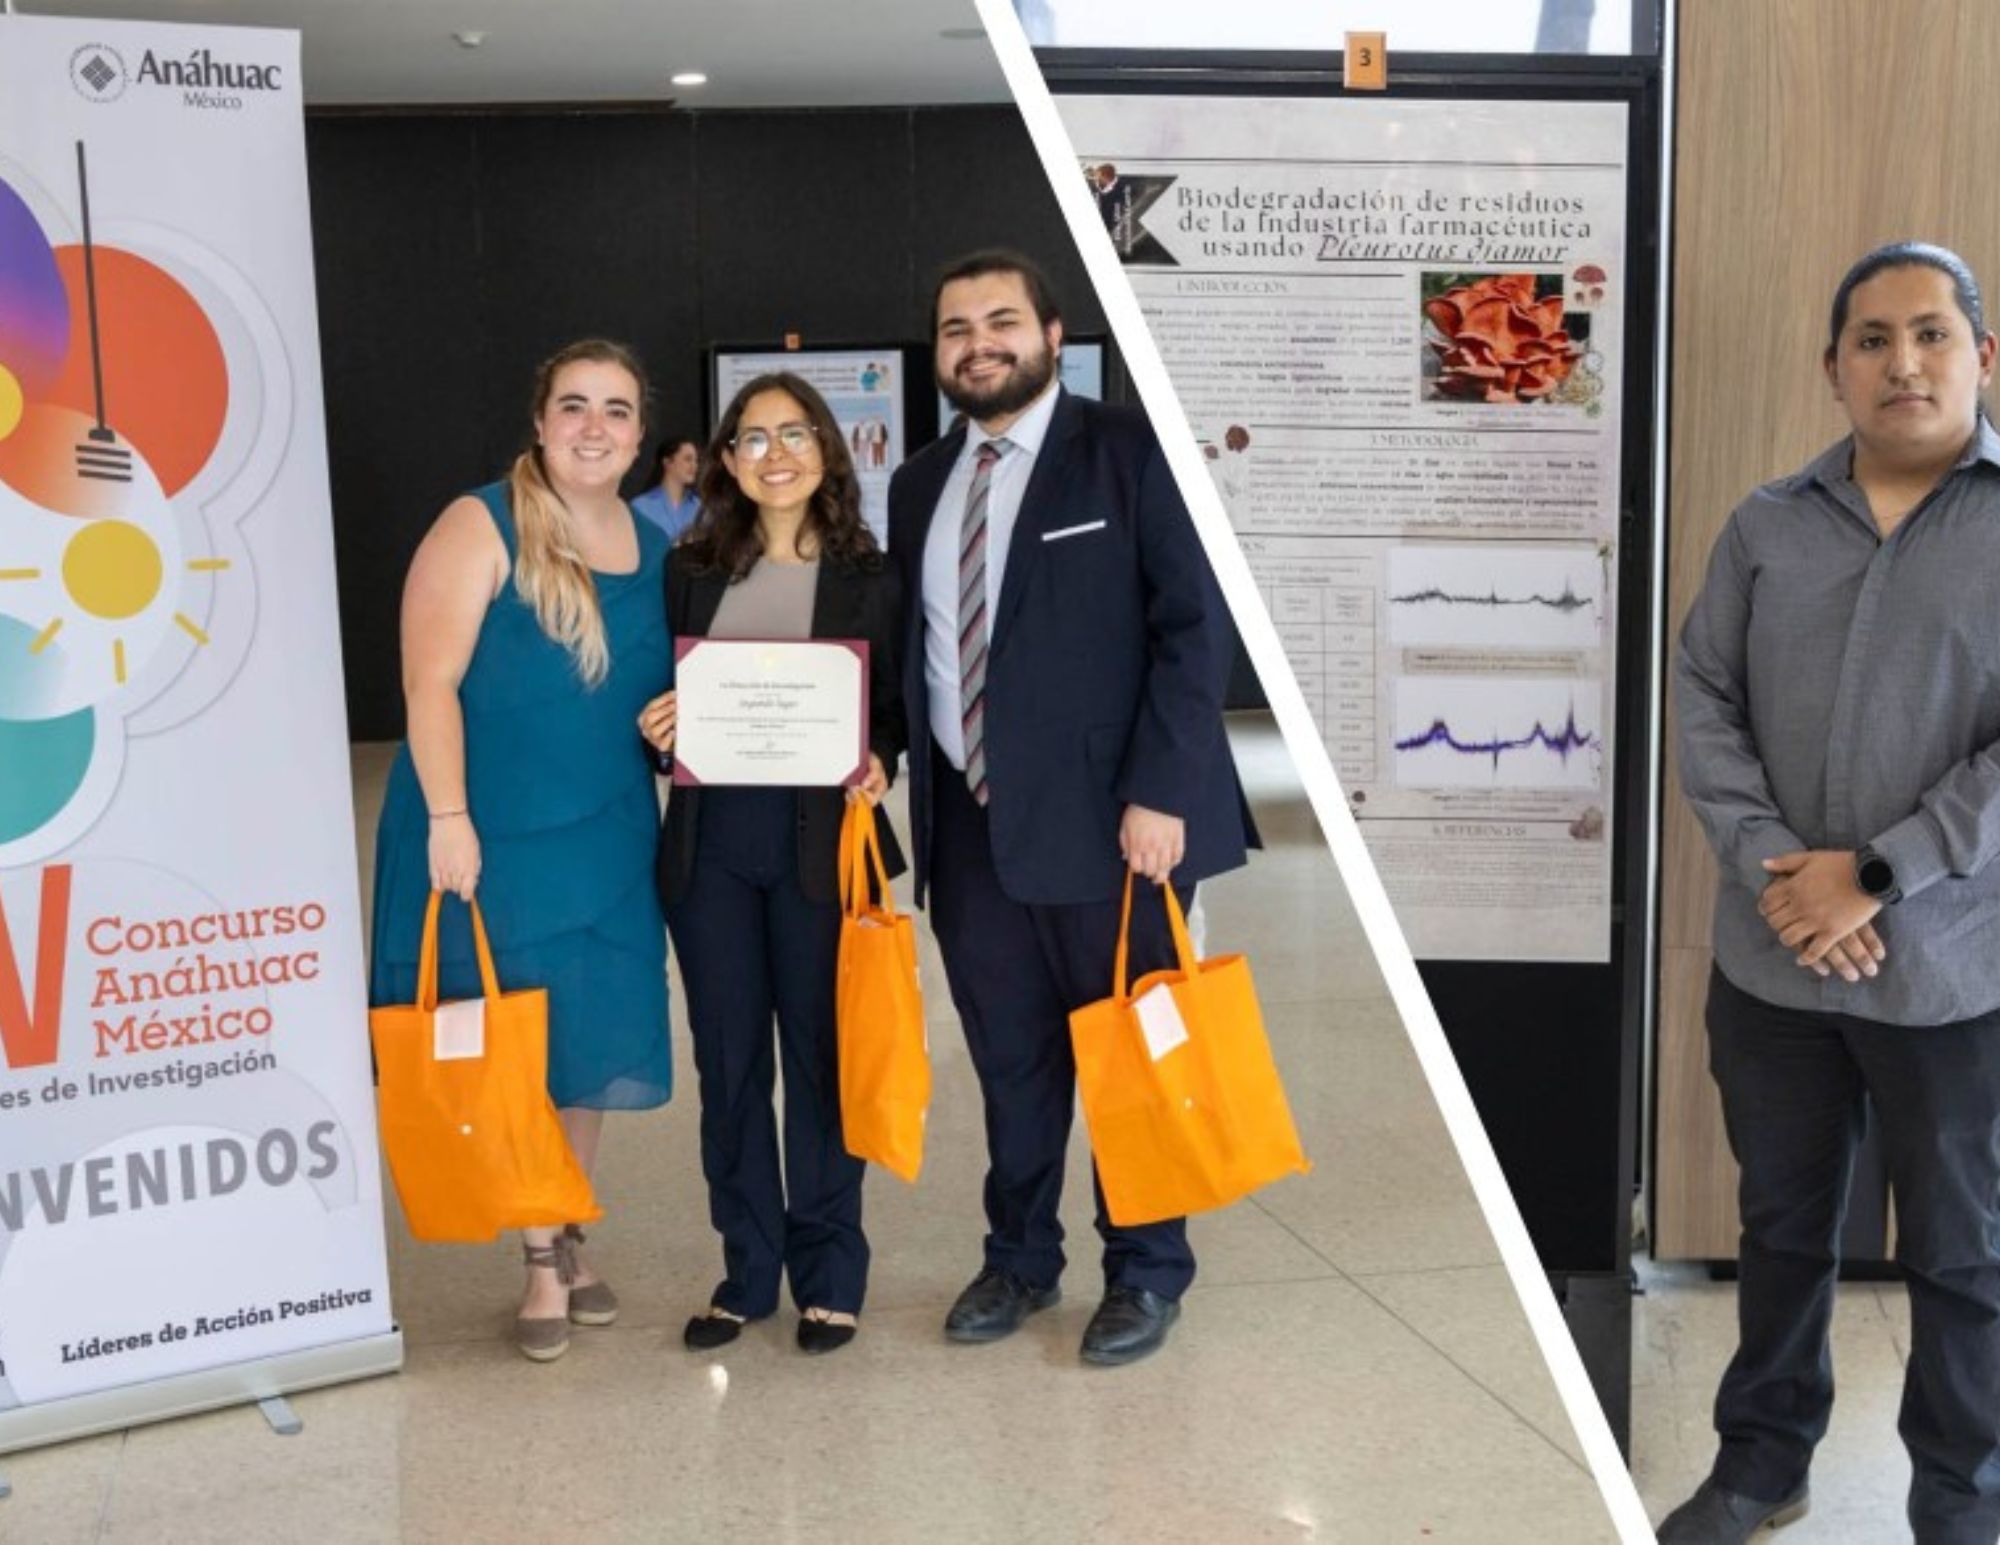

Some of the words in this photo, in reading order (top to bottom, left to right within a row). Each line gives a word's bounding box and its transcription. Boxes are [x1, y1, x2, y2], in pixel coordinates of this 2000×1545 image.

[136, 48, 282, 91] Anáhuac
[1359, 47, 1371, 67] 3
[182, 90, 242, 109] México
[1177, 186, 1403, 212] Biodegradación
[1417, 189, 1448, 212] de
[1178, 209, 1210, 233] de
[1222, 210, 1245, 233] la
[1400, 212, 1591, 239] farmacéutica
[1203, 234, 1304, 257] usando
[86, 902, 326, 956] Concurso
[90, 951, 320, 1008] Anáhuac
[94, 1003, 273, 1058] México
[41, 1076, 78, 1102] de
[89, 1049, 276, 1096] Investigación
[61, 1329, 153, 1363] Líderes
[159, 1321, 187, 1343] de
[194, 1303, 273, 1337] Acción
[279, 1287, 373, 1320] Positiva
